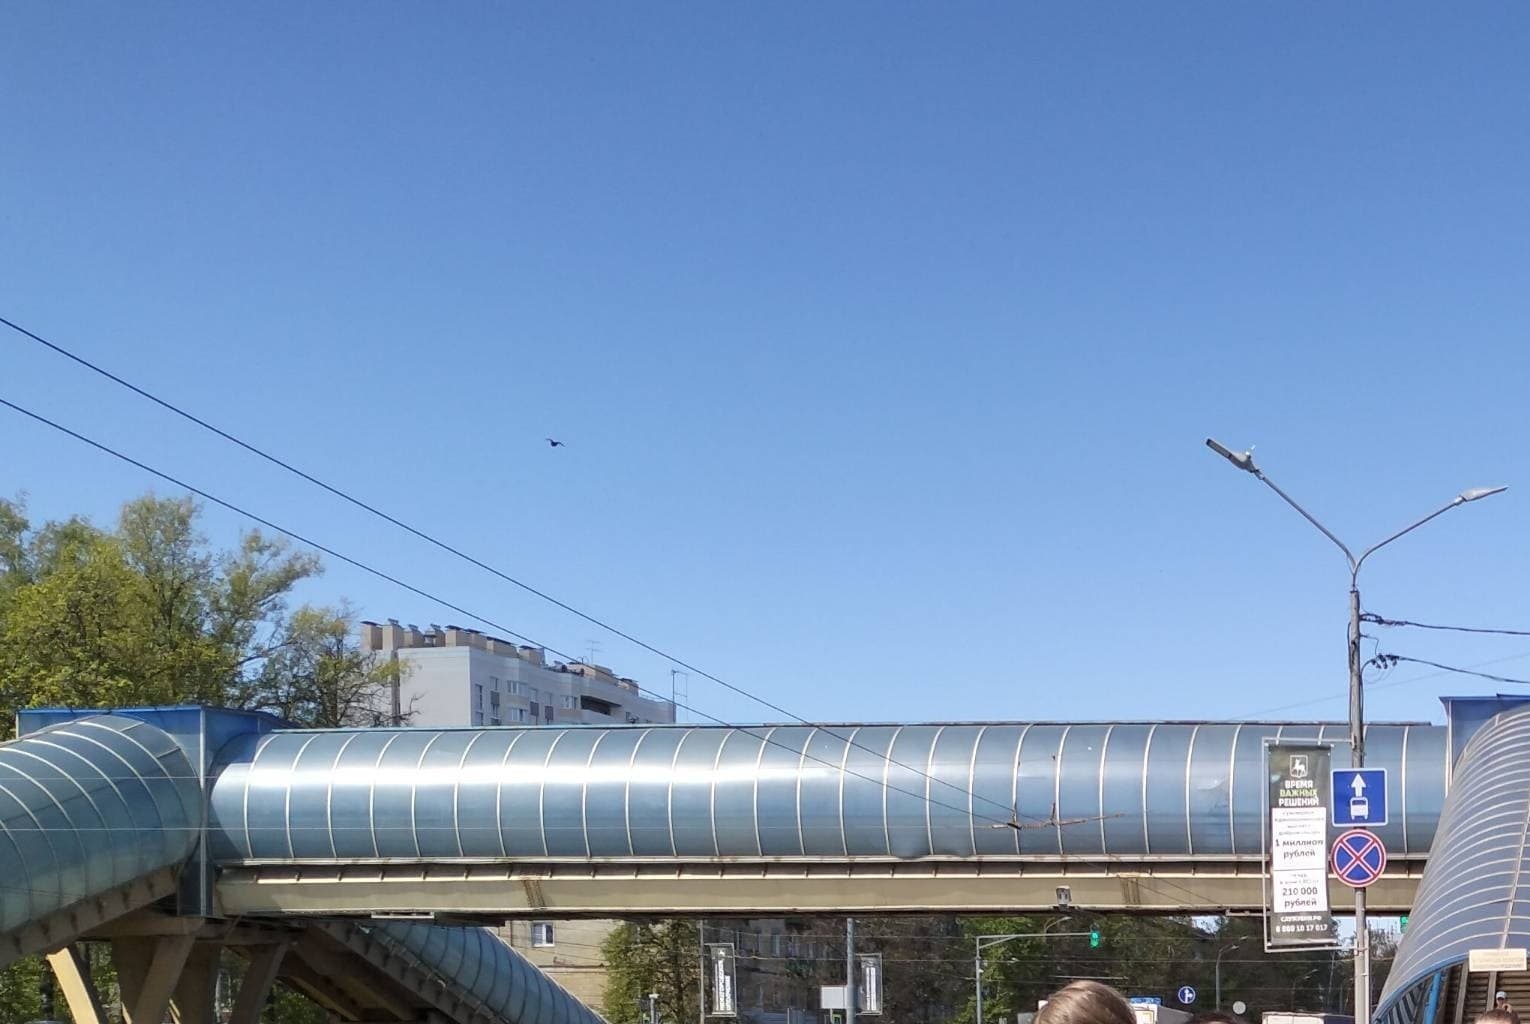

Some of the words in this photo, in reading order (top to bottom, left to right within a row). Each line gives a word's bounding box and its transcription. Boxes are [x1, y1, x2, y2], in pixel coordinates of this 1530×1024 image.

[1285, 780, 1314, 789] ВРЕМЯ
[1280, 788, 1318, 798] ВАЖНЫХ
[1278, 796, 1319, 807] РЕШЕНИЙ
[1275, 839, 1280, 847] 1
[1283, 849, 1316, 859] рублей
[1282, 887, 1299, 896] 210
[1301, 887, 1318, 895] 000
[1284, 898, 1317, 909] рублей
